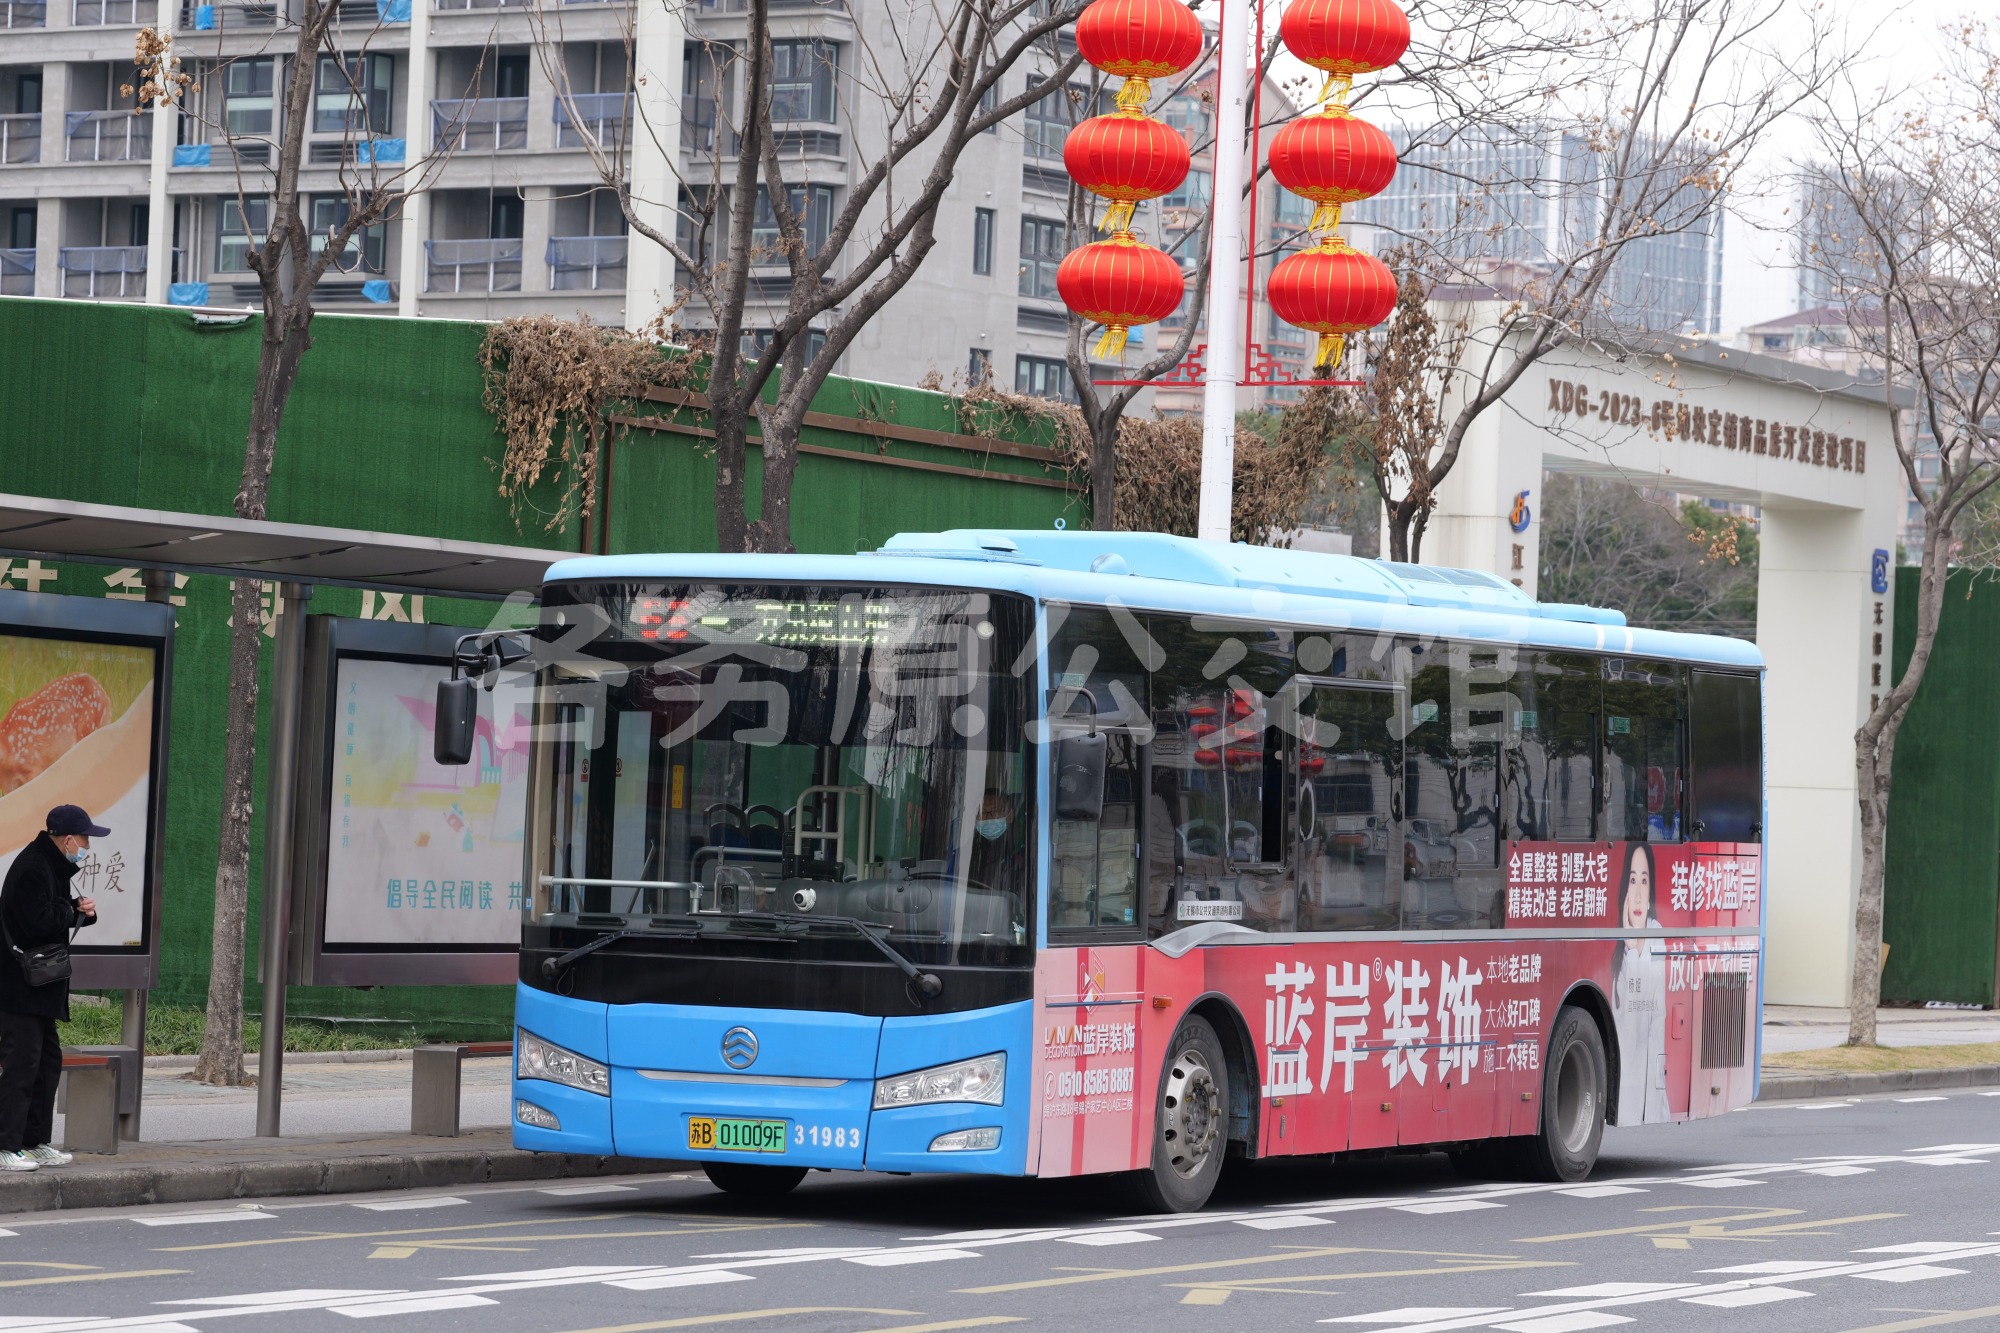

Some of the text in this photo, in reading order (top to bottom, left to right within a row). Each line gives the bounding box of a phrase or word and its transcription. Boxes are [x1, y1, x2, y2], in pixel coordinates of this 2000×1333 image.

[1509, 851, 1609, 883] 全屋整装 别墅大宅
[387, 879, 493, 910] 倡导全民阅读
[1671, 860, 1757, 912] 装修找蓝岸
[1508, 886, 1608, 919] 精装改造 老房翻新
[1486, 953, 1542, 985] 本地老品牌
[1668, 941, 1754, 992] 放心又划算
[1484, 997, 1541, 1029] 大众好口碑
[1044, 1044, 1083, 1060] DECORATION
[1083, 1022, 1136, 1056] 蓝岸装饰
[1482, 1042, 1539, 1073] 施工不转包
[1058, 1066, 1134, 1098] 0510 8585 8887
[691, 1122, 784, 1148] 苏B 01009F
[794, 1125, 861, 1149] 31983
